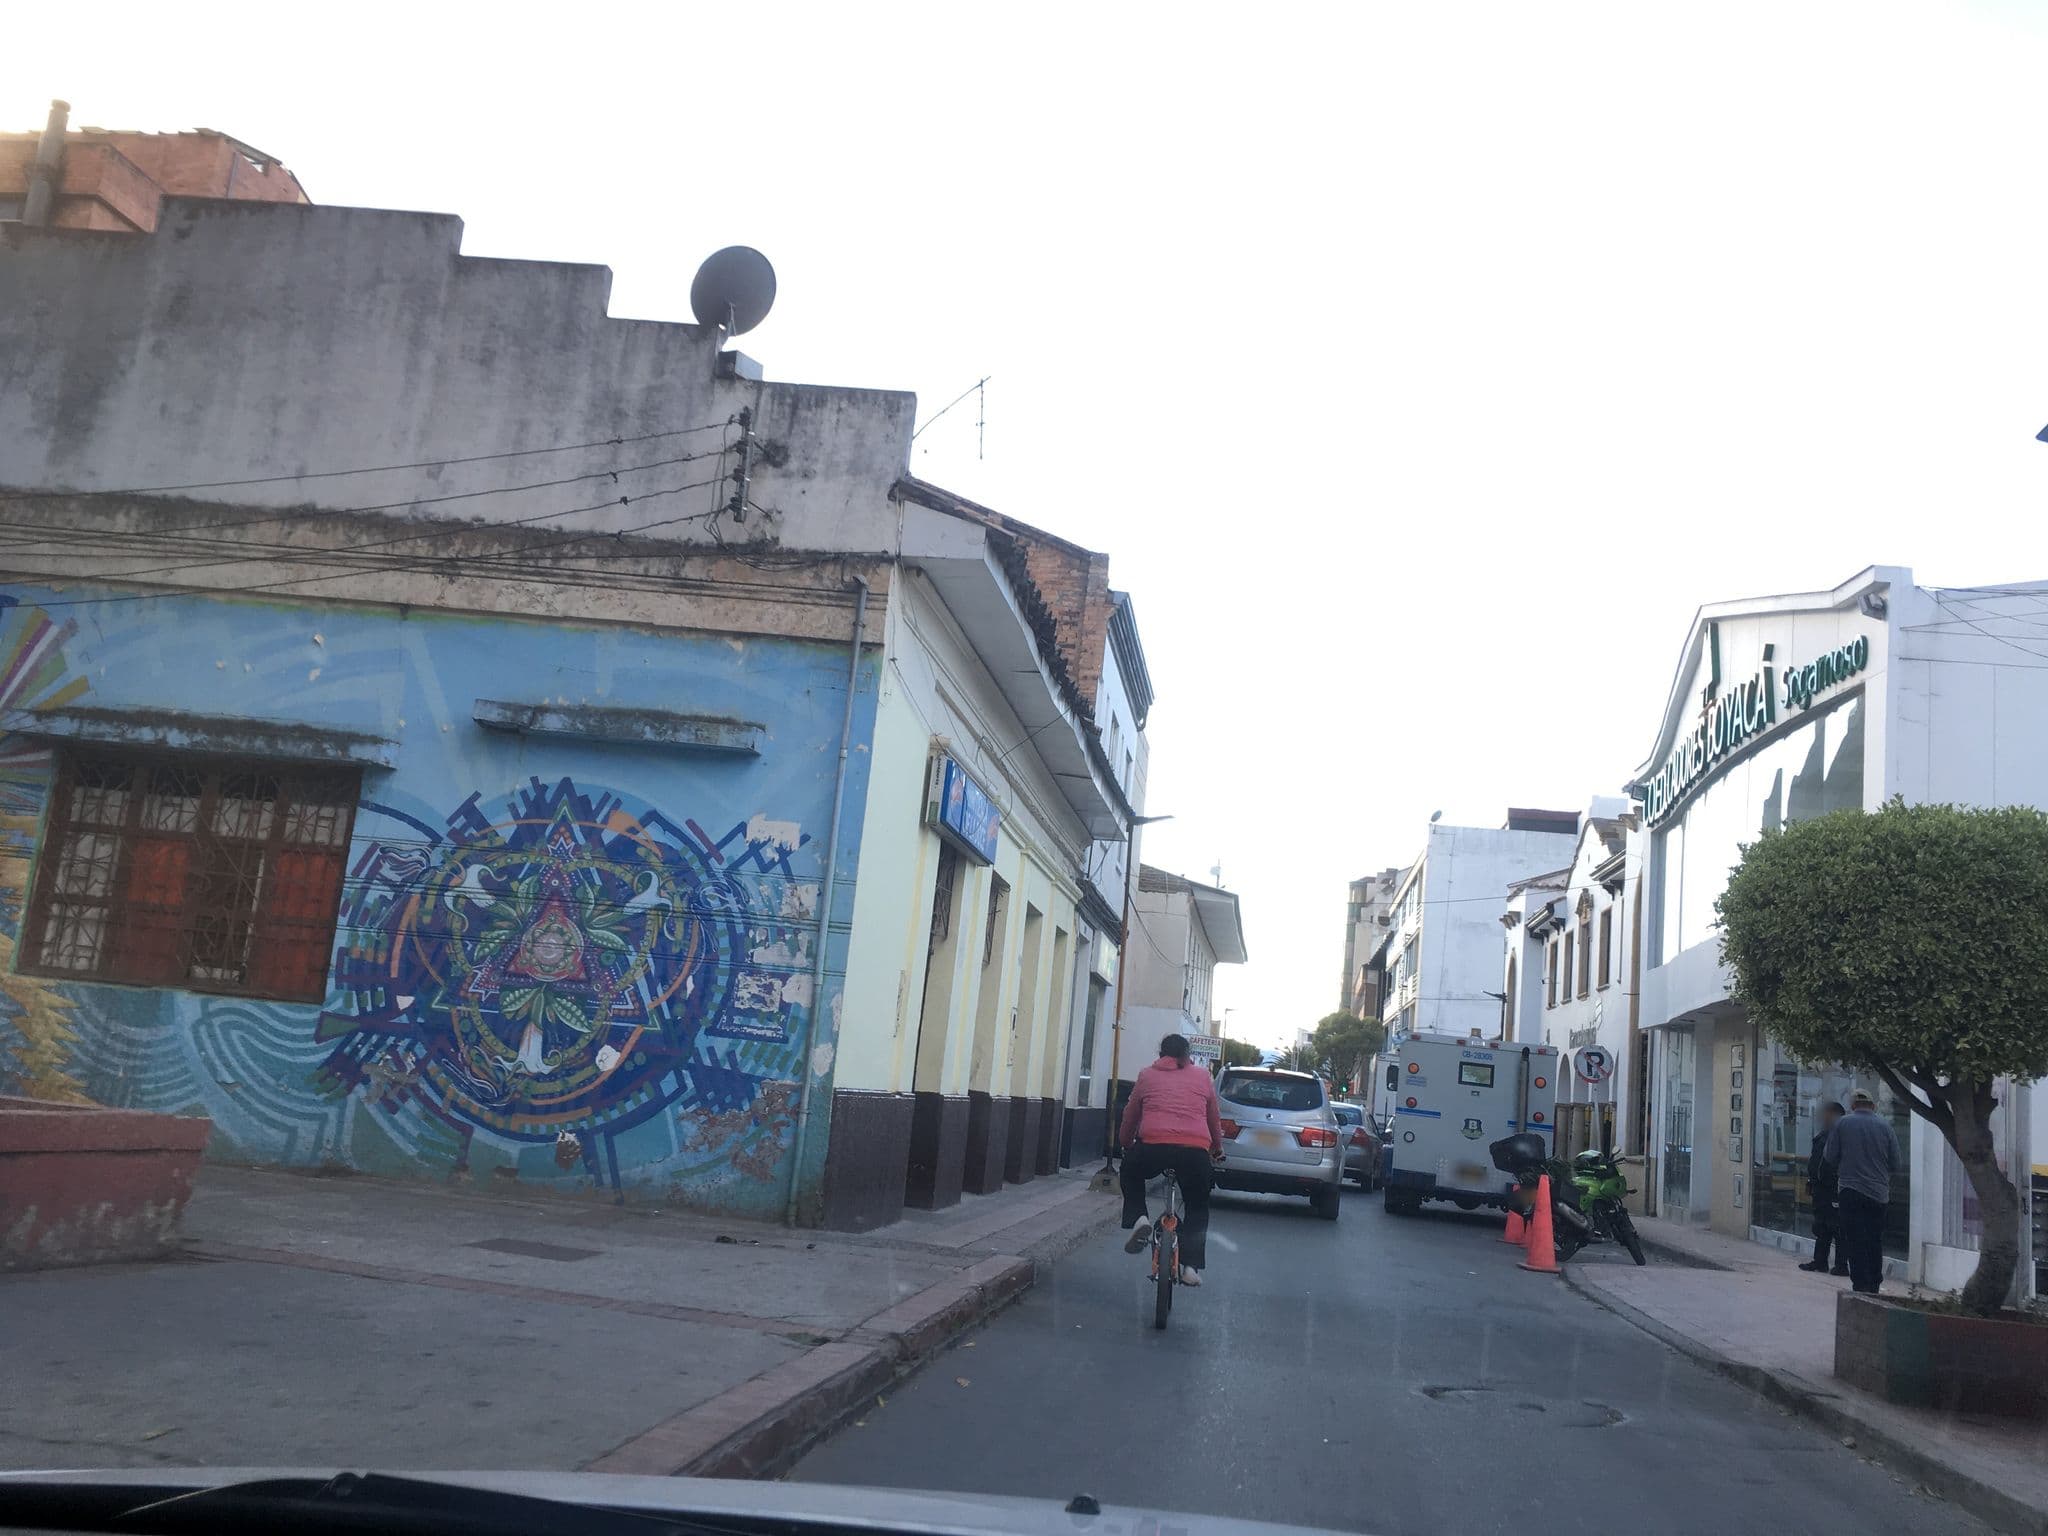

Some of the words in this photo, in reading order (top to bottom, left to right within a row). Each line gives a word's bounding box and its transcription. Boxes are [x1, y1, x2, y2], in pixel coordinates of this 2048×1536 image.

[1706, 644, 1775, 764] BOYACÁ
[1781, 634, 1868, 711] Sogamoso
[1586, 1052, 1605, 1076] P
